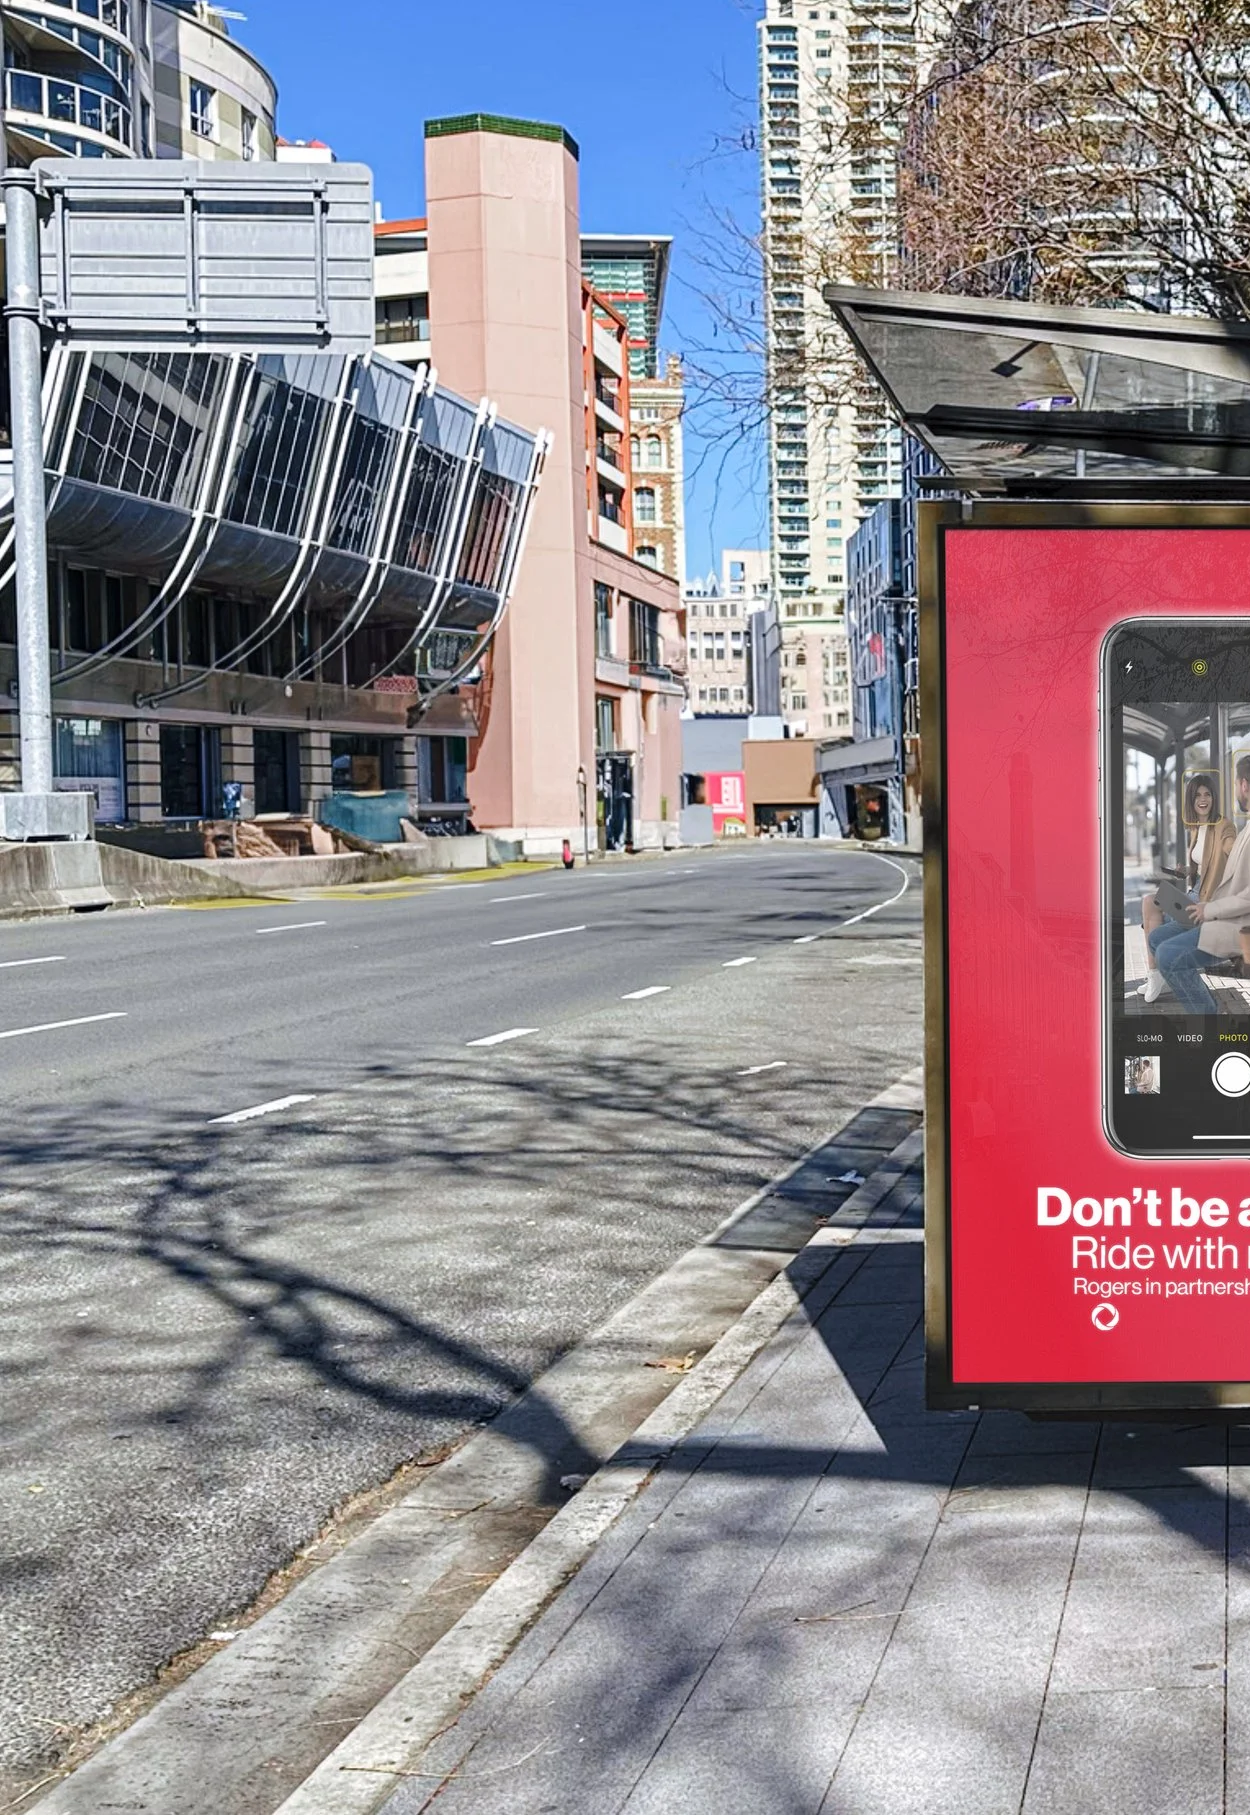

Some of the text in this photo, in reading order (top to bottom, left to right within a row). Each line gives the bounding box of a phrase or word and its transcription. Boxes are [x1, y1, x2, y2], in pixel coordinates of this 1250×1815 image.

[1136, 1034, 1163, 1042] SLO-MO
[1177, 1034, 1203, 1042] VIDEO
[1219, 1033, 1249, 1042] PHOTO
[1036, 1186, 1162, 1228] Don’t
[1171, 1187, 1230, 1228] be
[1072, 1235, 1155, 1270] Ride
[1162, 1236, 1239, 1270] with
[1073, 1277, 1143, 1299] Rogers
[1145, 1277, 1162, 1295] in
